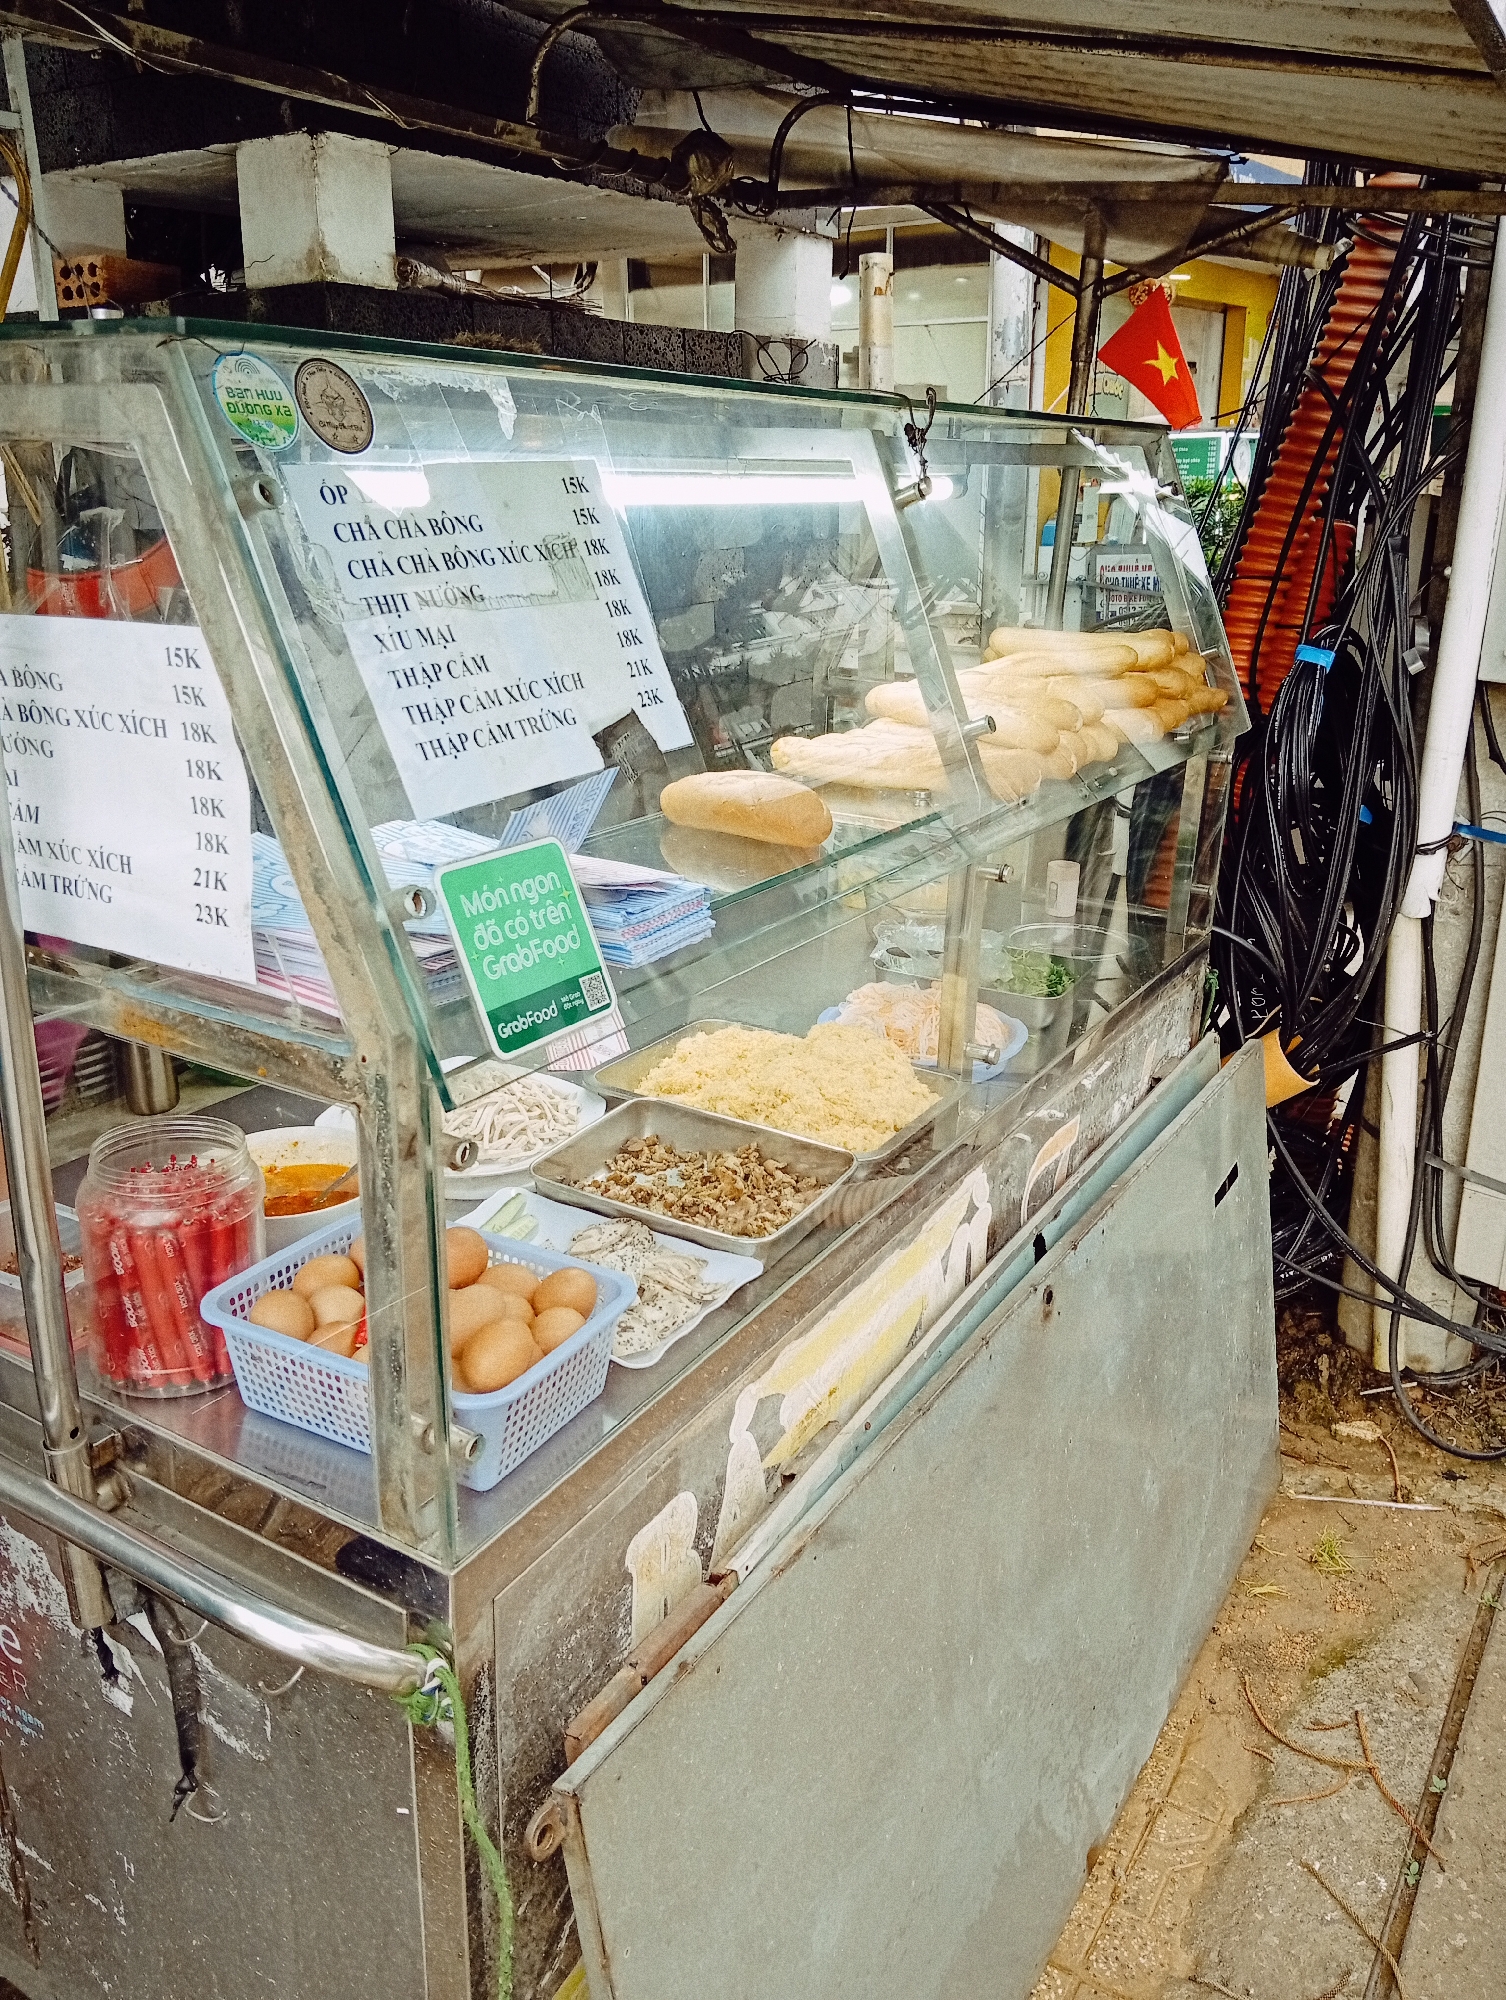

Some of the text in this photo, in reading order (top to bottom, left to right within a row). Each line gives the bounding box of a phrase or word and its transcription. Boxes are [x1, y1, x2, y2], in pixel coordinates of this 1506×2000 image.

[319, 478, 348, 505] ỐP
[561, 476, 590, 495] 15K
[333, 507, 600, 543] CHẢ CHÀ BÔNG 15K
[347, 550, 395, 580] CHẢ
[397, 547, 440, 575] CHÀ
[441, 544, 496, 572] BÔNG
[497, 540, 534, 565] XÚC
[583, 538, 611, 557] 18K
[359, 568, 621, 619] THỊT NƯỚNG 18K
[1106, 594, 1122, 603] OTO
[373, 598, 632, 654] XÍU MẠI 18K
[163, 646, 202, 670] 15K
[387, 628, 644, 690] THẬP CẨM 18K
[10, 663, 64, 692] BÔNG
[171, 683, 208, 709] 15K
[401, 658, 654, 725] THẬP CẨM XÚC XÍCH 21K
[18, 699, 72, 728] BÔNG
[75, 704, 116, 732] XÚC
[119, 707, 169, 740] XÍCH
[181, 720, 219, 745] 18K
[415, 687, 664, 761] THẬP CẨM TRỨNG 23K
[1, 731, 225, 782] ƯỚNG 18K
[9, 797, 230, 856] ẨM 18K
[189, 795, 227, 819] 18K
[46, 838, 83, 866] XÚC
[88, 844, 134, 876] XÍCH
[192, 866, 229, 893] 21K
[50, 873, 114, 905] TRỨNG
[194, 902, 230, 928] 23K
[459, 871, 562, 918] Món ngon
[473, 899, 573, 951] đã có trên
[482, 922, 581, 981] GrabFood
[497, 999, 559, 1040] GrabFood
